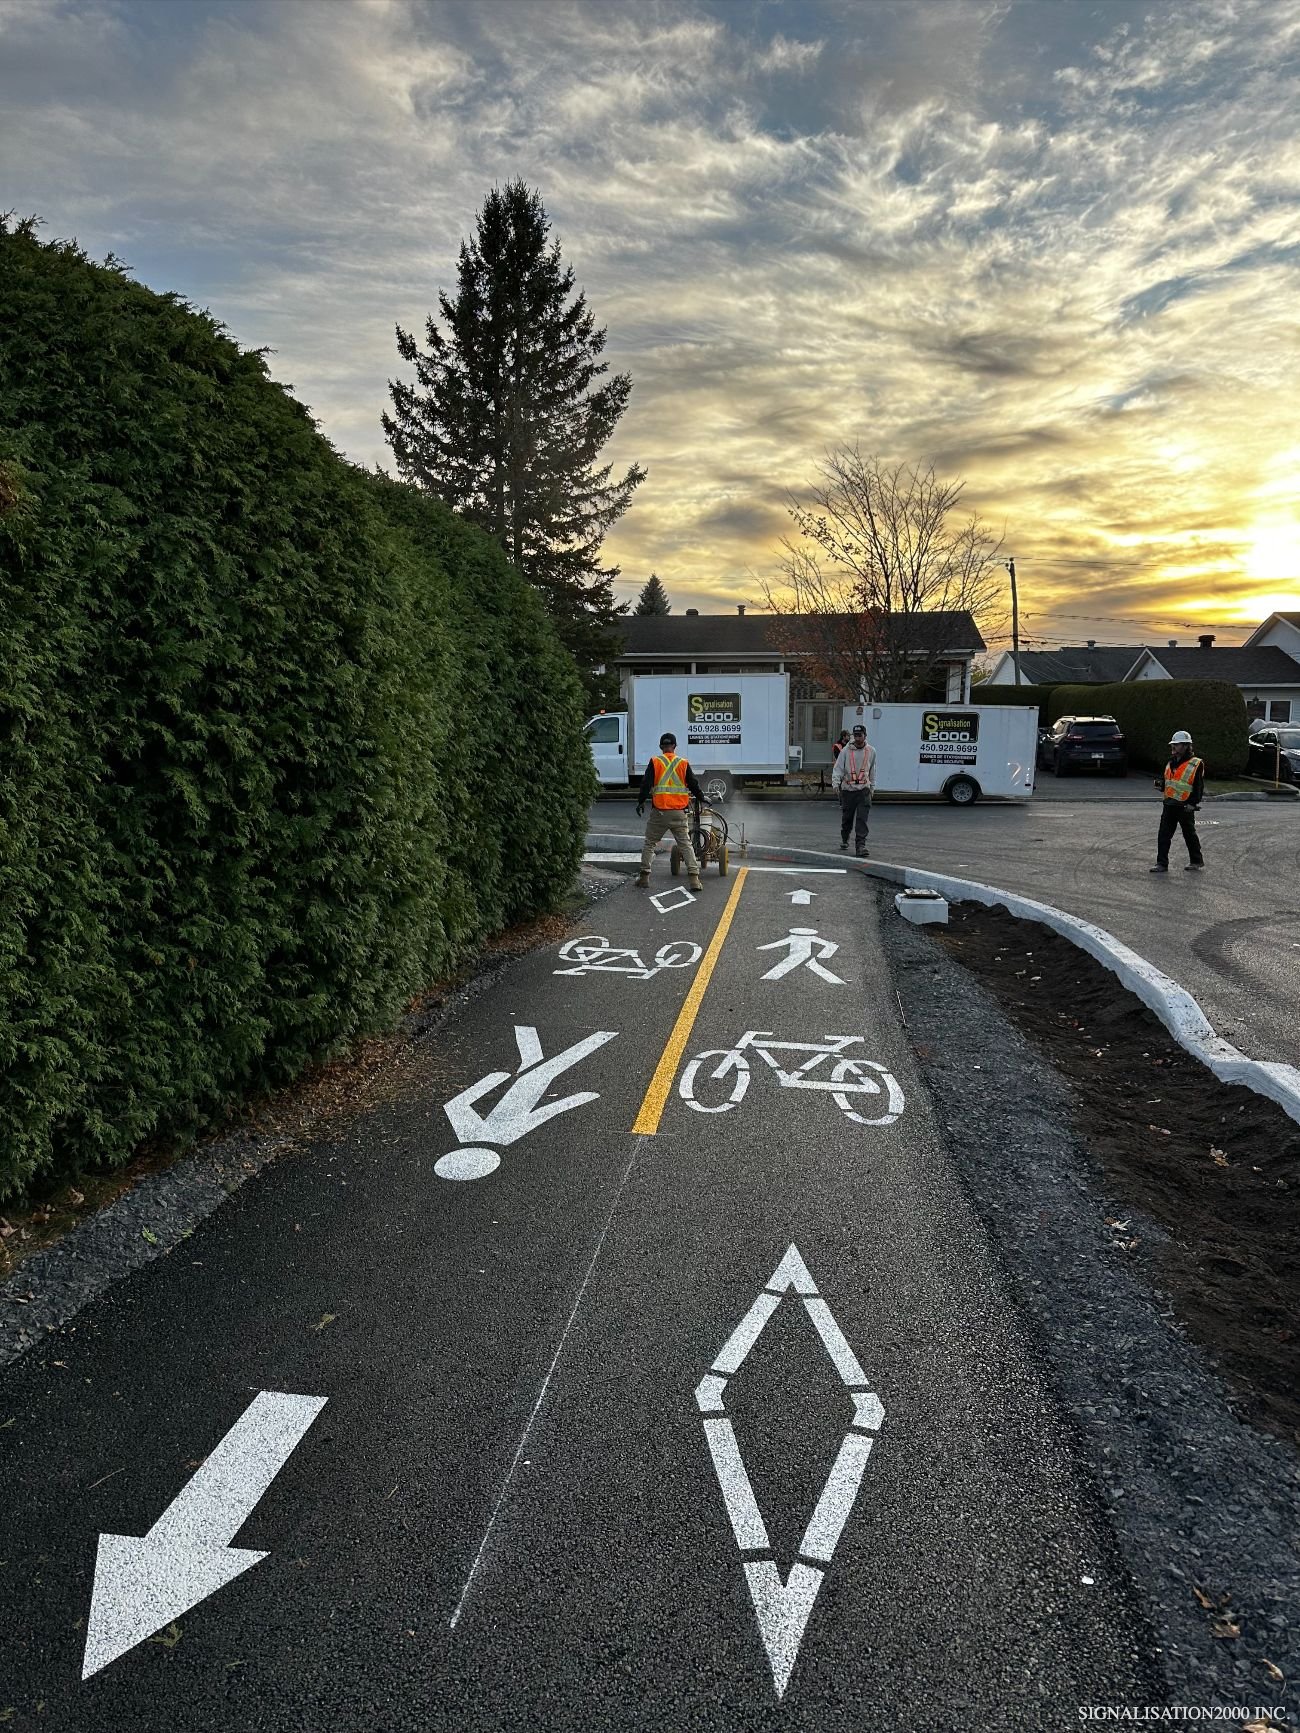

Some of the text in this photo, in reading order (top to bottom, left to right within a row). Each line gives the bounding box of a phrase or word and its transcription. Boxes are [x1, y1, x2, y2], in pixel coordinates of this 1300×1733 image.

[691, 696, 733, 713] Signalisation
[695, 713, 733, 721] 2000
[925, 714, 971, 733] Signalisation
[928, 732, 970, 741] 2000
[920, 744, 978, 752] 450.928.9699
